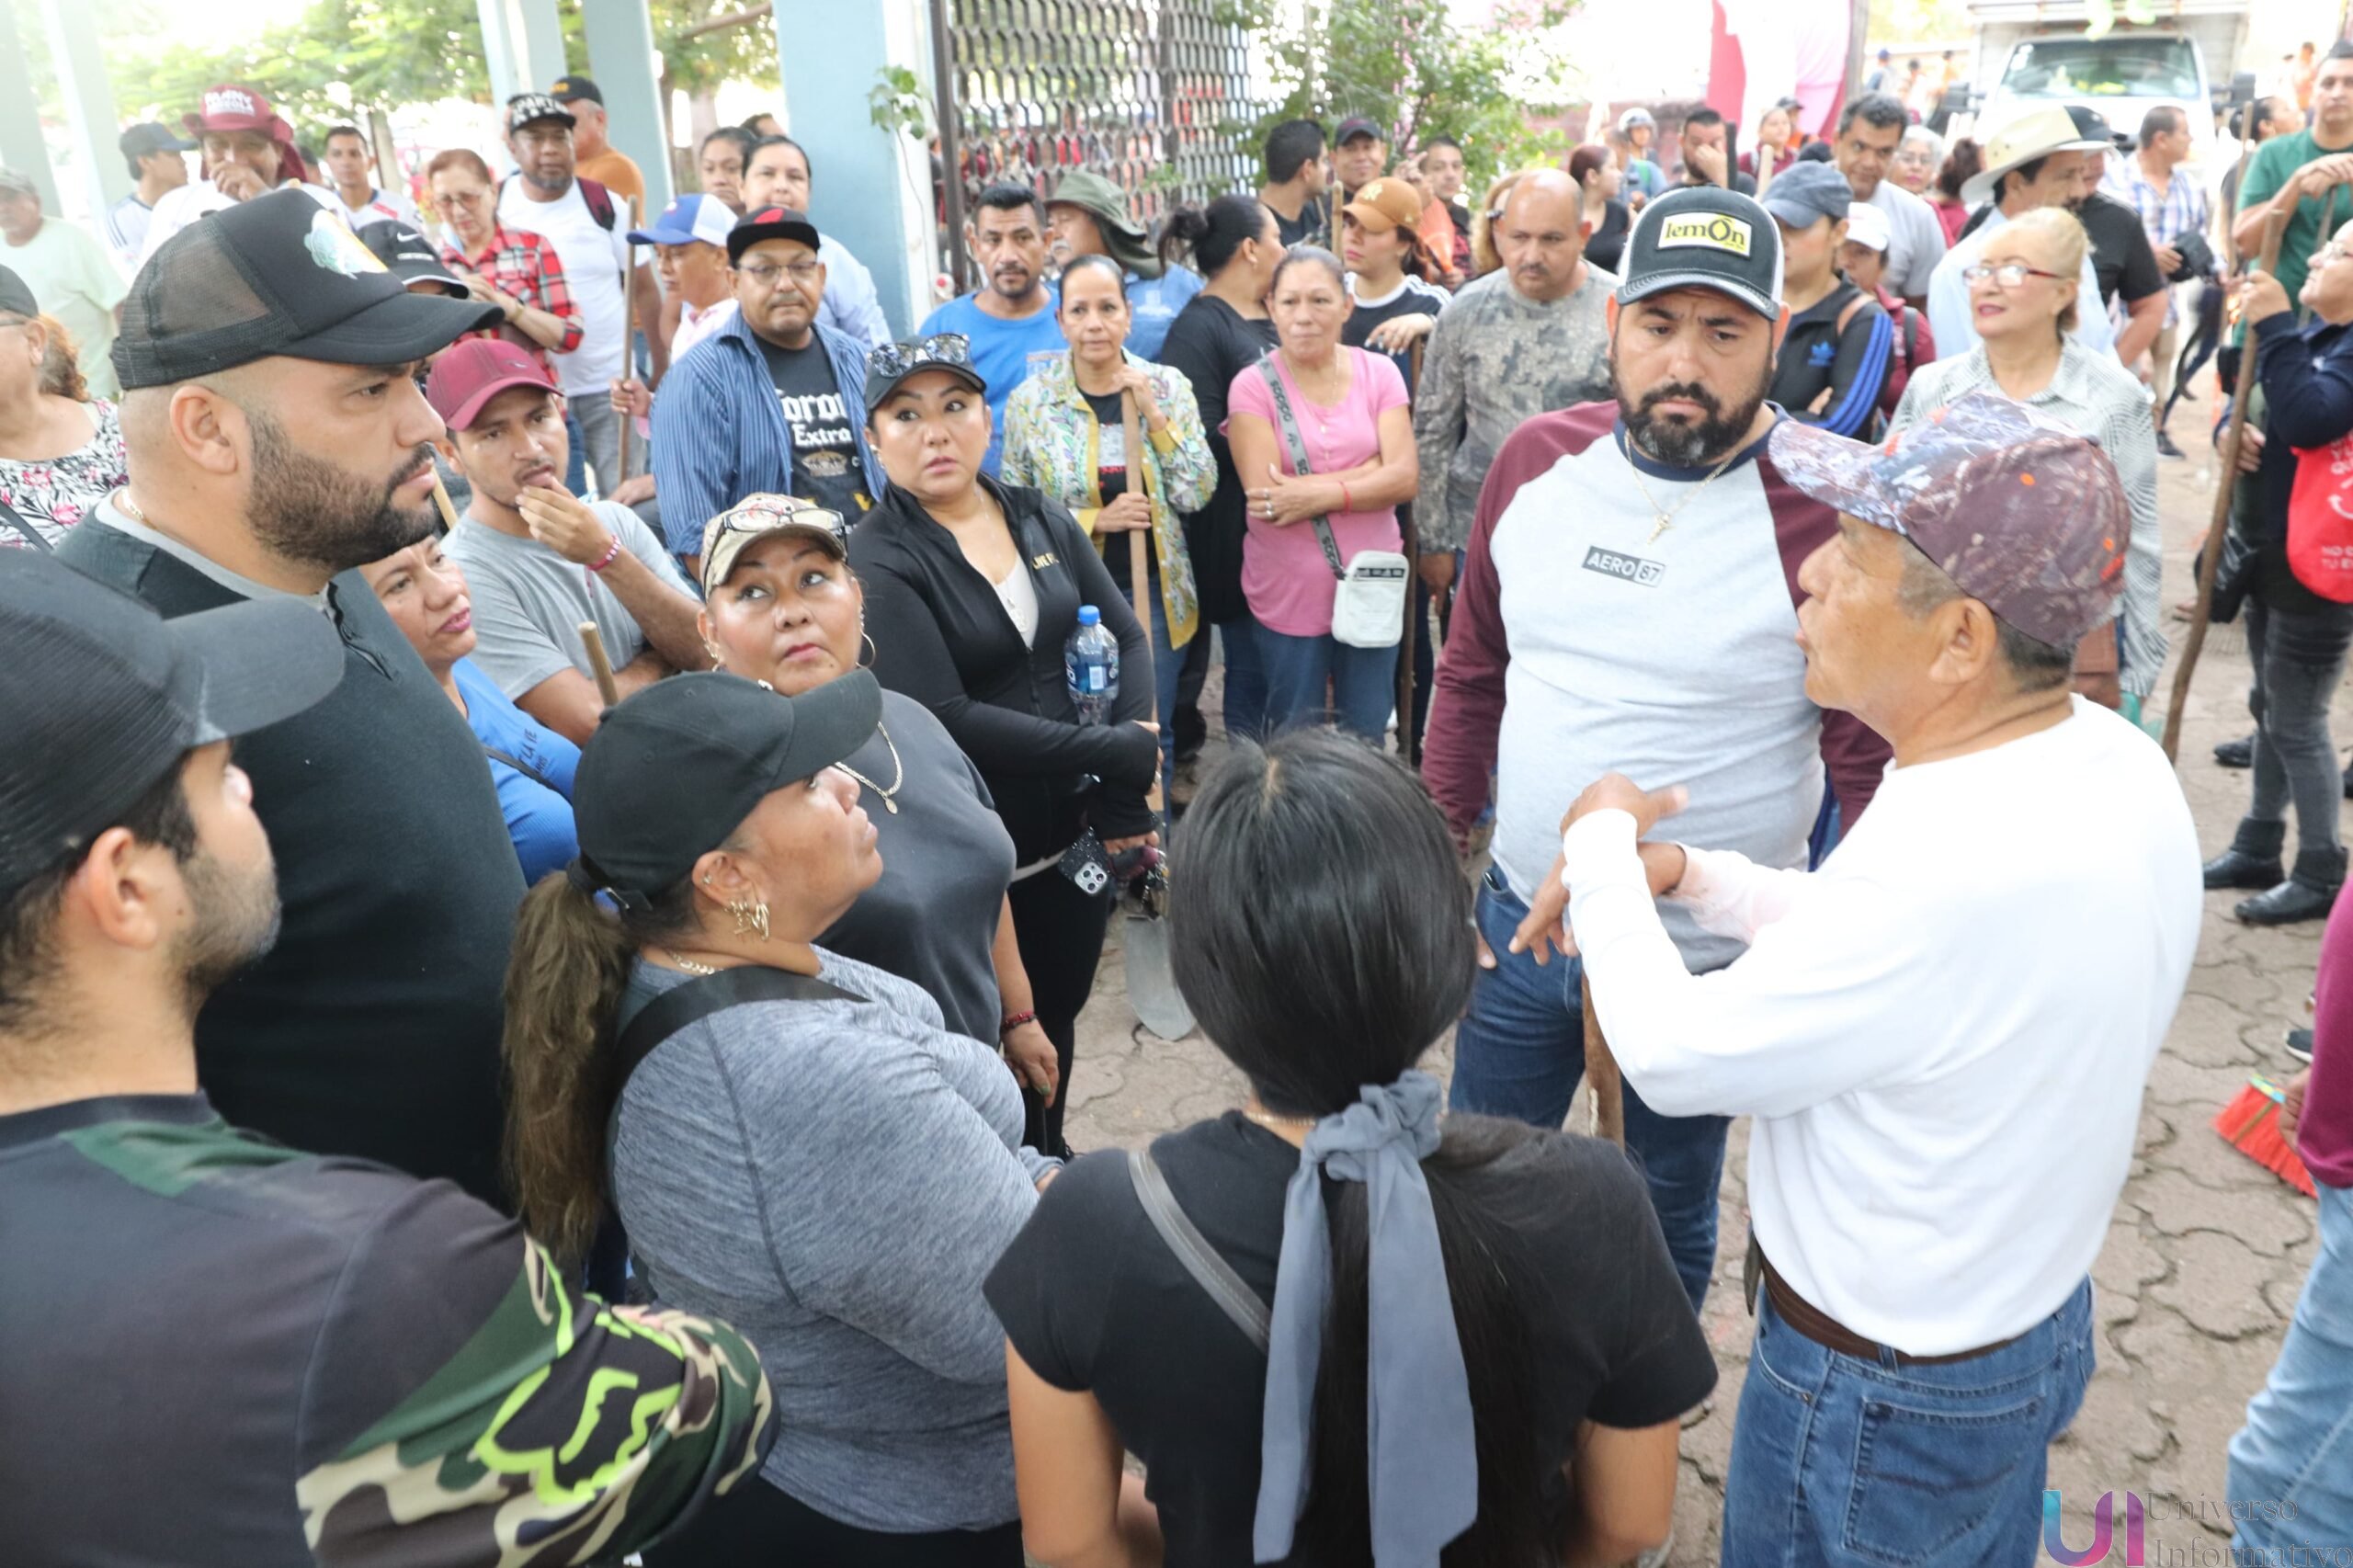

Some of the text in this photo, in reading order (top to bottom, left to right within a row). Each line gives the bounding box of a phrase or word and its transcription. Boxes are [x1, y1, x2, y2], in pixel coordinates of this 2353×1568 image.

[1270, 380, 1292, 422] adidas
[791, 424, 853, 448] Extra
[1586, 551, 1636, 576] AERO
[1639, 564, 1660, 582] 87
